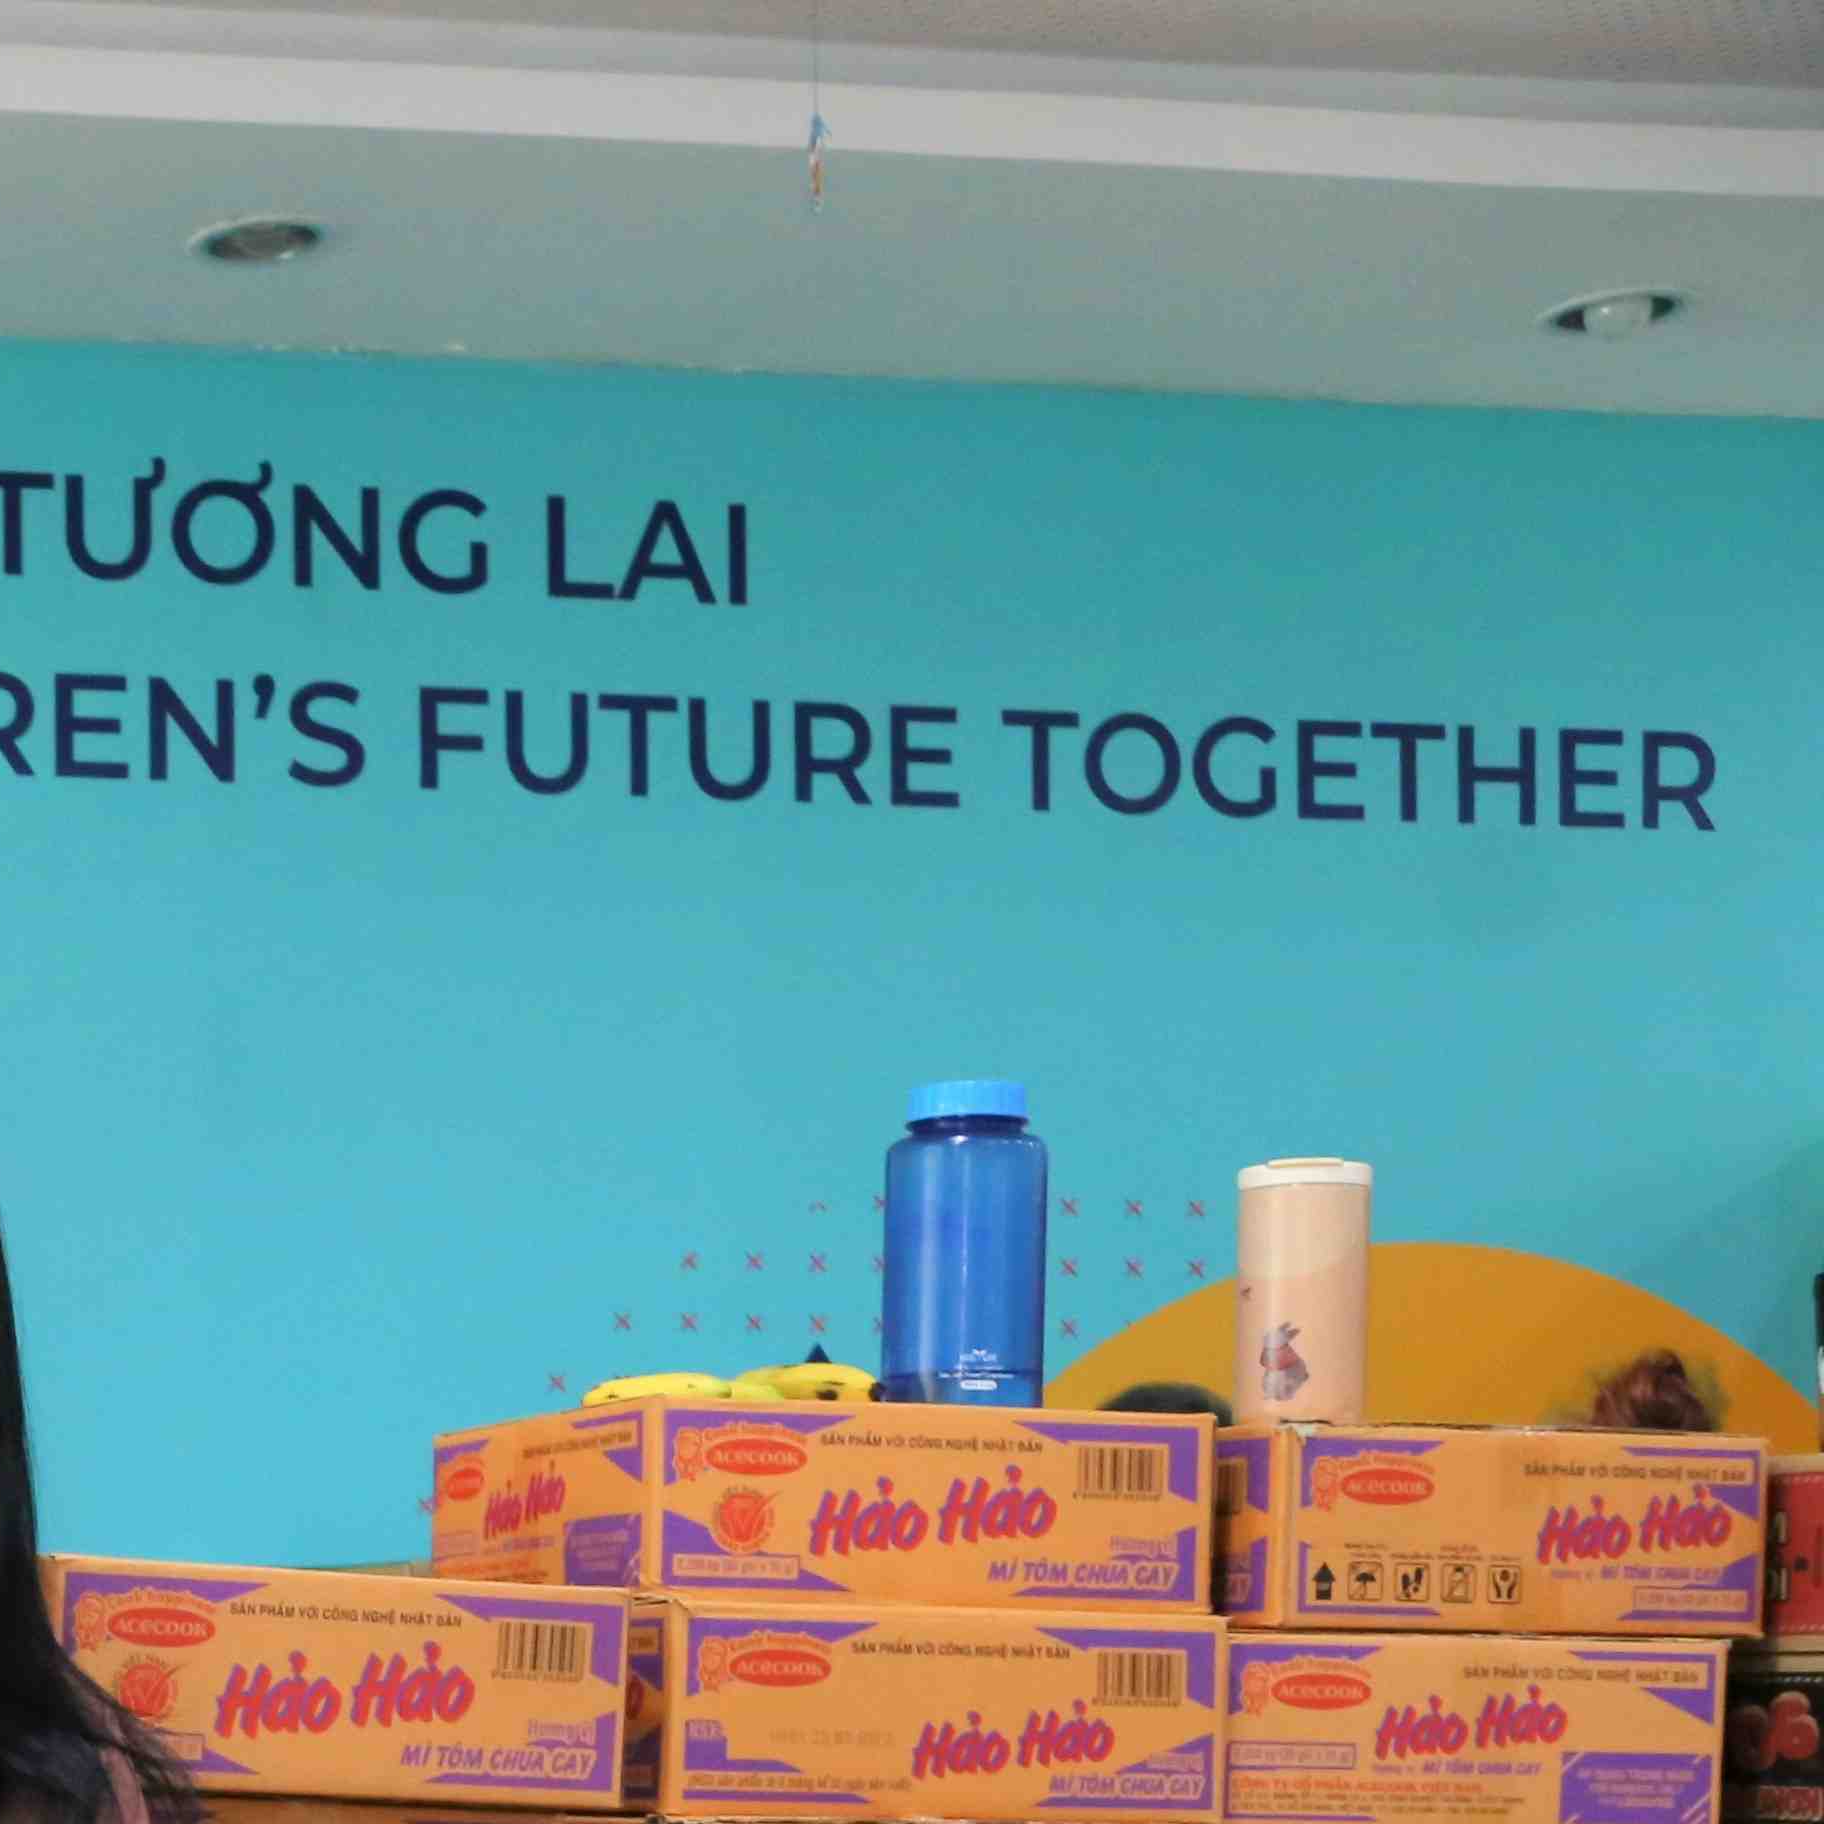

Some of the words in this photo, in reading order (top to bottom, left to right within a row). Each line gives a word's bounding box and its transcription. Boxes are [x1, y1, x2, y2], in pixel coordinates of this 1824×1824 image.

[544, 496, 750, 606] LAI
[417, 686, 961, 808] FUTURE
[1005, 711, 1717, 833] TOGETHER
[810, 1475, 929, 1557] Hảo
[938, 1464, 1057, 1544] Hảo
[214, 1651, 342, 1739] Hảo
[350, 1640, 475, 1728] Hảo
[1375, 1696, 1470, 1760] Hảo
[1475, 1686, 1568, 1749] Hảo
